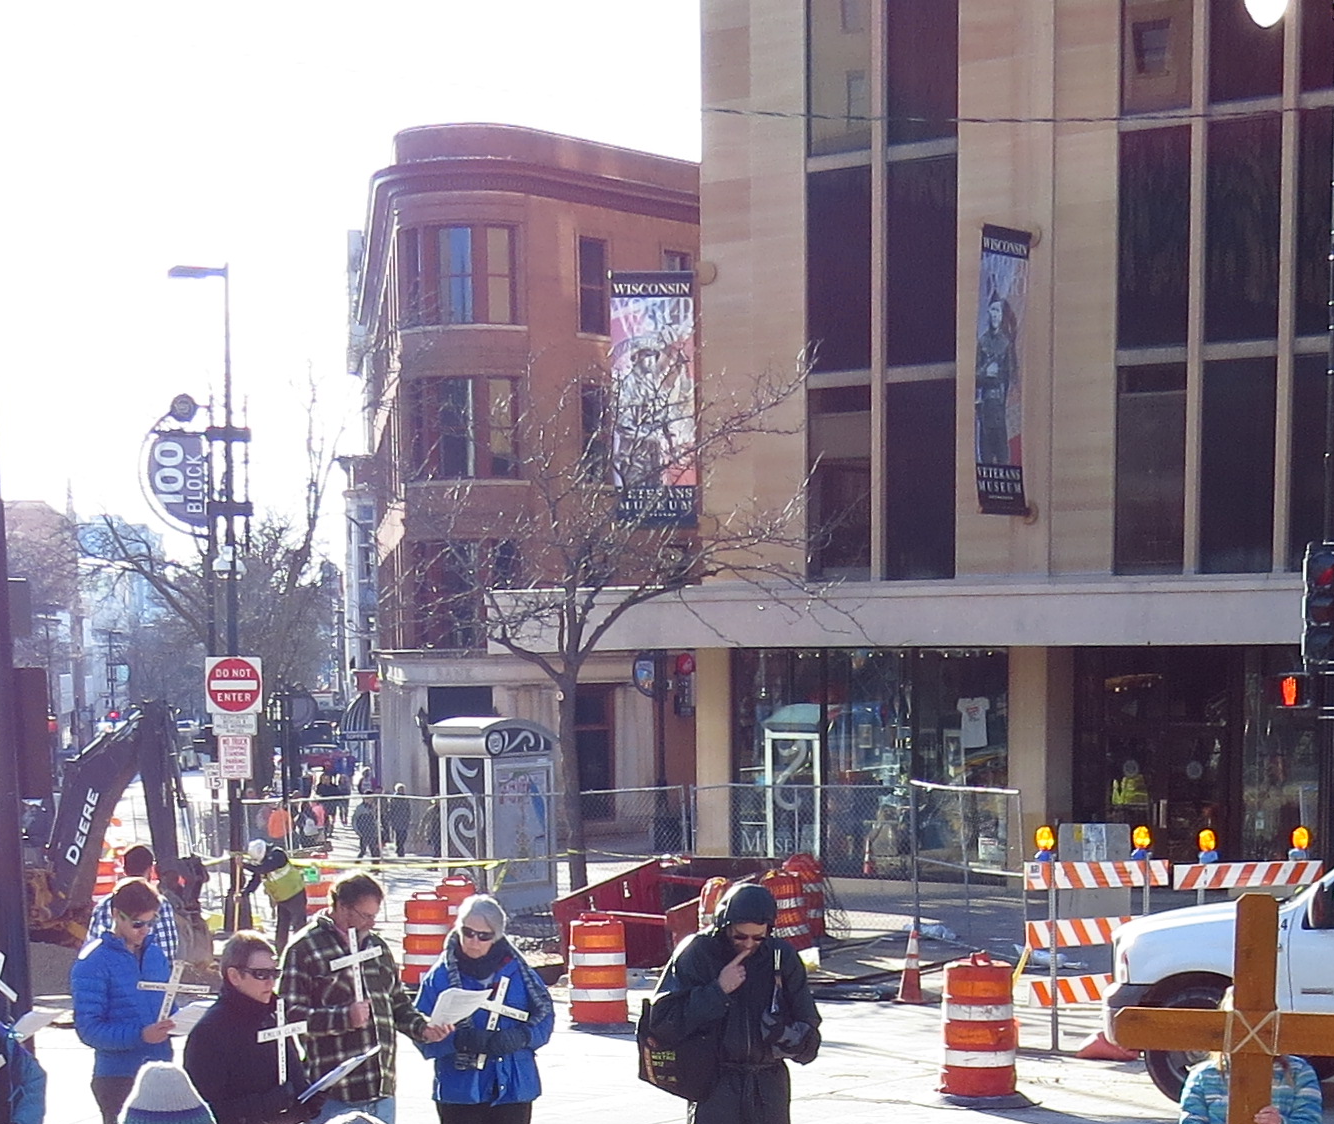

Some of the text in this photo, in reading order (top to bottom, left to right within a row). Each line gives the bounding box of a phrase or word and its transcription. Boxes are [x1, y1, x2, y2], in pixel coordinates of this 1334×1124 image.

[983, 237, 1027, 256] WISCONSIN
[612, 282, 690, 295] WISCONSIN
[154, 441, 185, 503] 100
[977, 466, 1021, 480] VETERANS
[186, 454, 204, 514] BLOCK
[978, 480, 1022, 494] MUSEUM
[215, 668, 252, 678] DO NOT
[217, 692, 252, 702] ENTER
[209, 777, 222, 788] 15
[65, 788, 100, 866] DEERE
